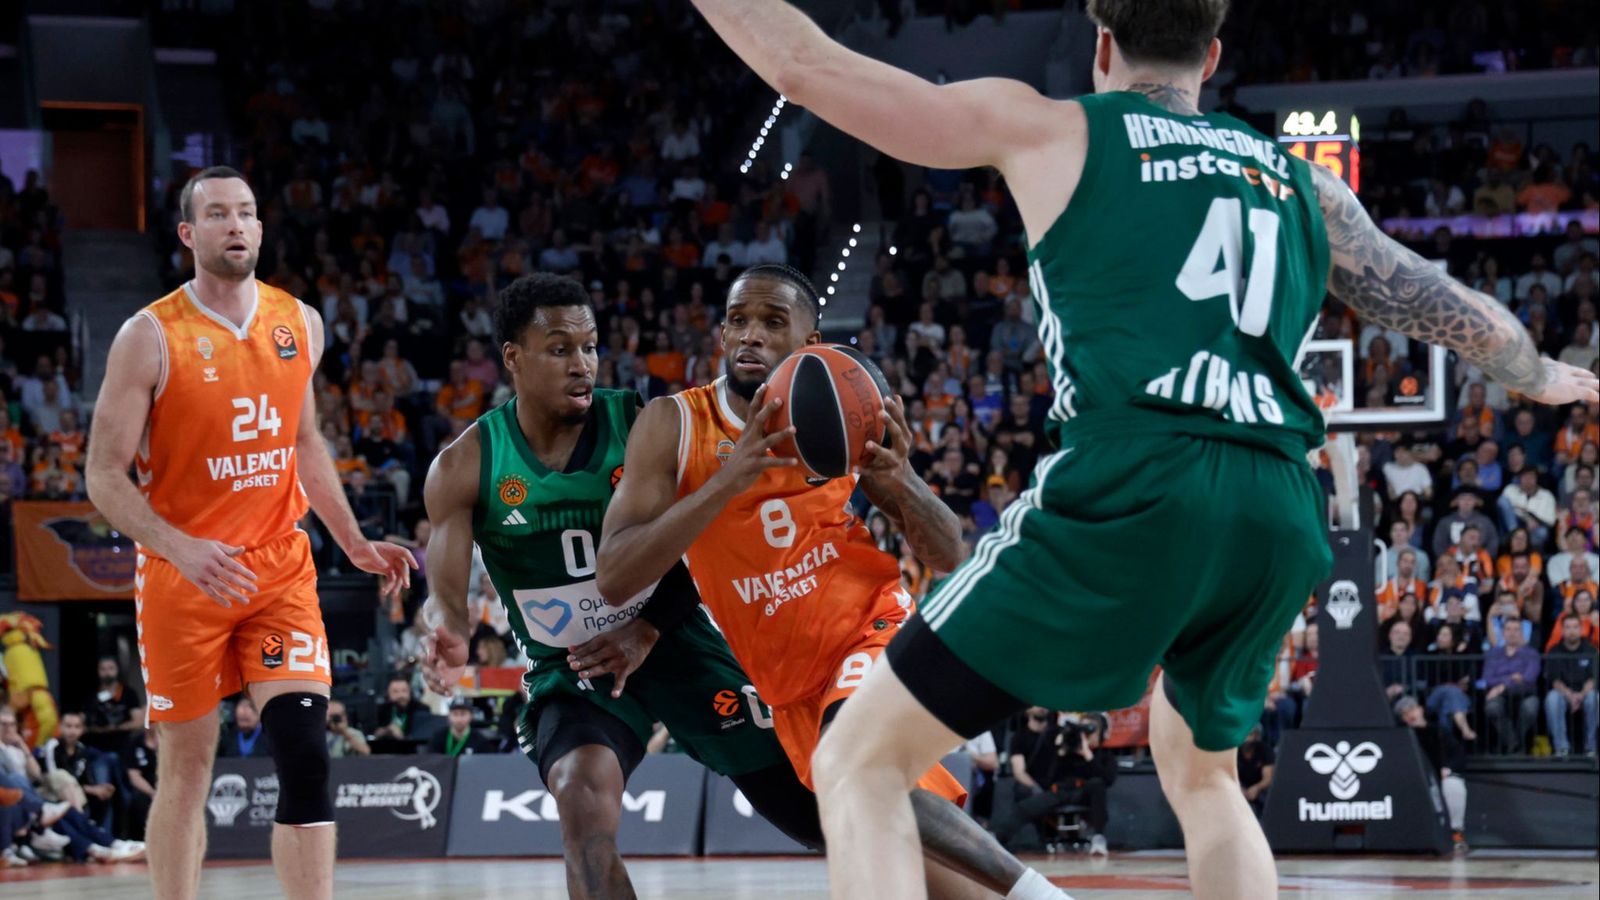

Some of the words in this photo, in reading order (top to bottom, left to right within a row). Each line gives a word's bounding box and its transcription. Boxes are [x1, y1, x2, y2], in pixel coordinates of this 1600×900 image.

[1283, 111, 1338, 136] 43.4
[1140, 151, 1295, 202] instacar
[1175, 197, 1280, 337] 41
[1145, 350, 1285, 425] ATHNS
[231, 394, 283, 442] 24
[760, 498, 797, 548] 8
[561, 529, 598, 578] 0
[764, 575, 819, 617] BASKET
[288, 631, 331, 676] 24
[836, 652, 874, 689] 8
[482, 789, 667, 822] KM
[1299, 795, 1393, 822] hummel
